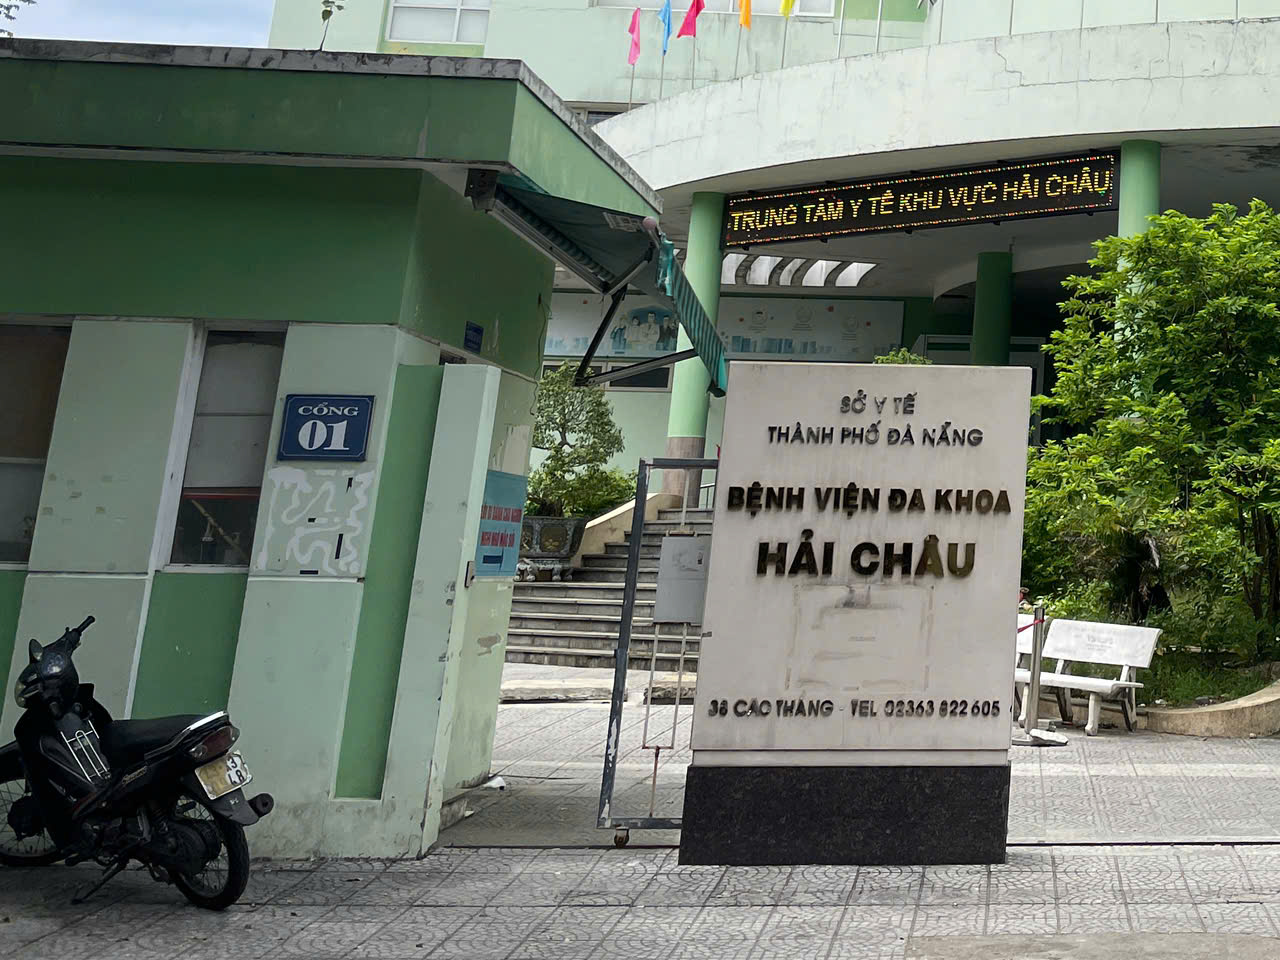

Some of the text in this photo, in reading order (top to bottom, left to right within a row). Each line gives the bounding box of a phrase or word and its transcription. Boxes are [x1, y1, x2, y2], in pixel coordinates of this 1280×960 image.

[731, 204, 797, 232] TRUNG
[850, 199, 863, 218] Y
[899, 190, 943, 212] KHU
[1046, 167, 1110, 197] CHÂU
[840, 389, 918, 414] SỞ Y TẾ
[298, 419, 350, 450] 01
[840, 420, 881, 445] PHỐ
[727, 481, 1012, 520] BỆNH VIỆN ĐA KHOA
[756, 528, 977, 578] HẢI CHÂU
[733, 698, 772, 718] CAO
[851, 699, 878, 718] TEL
[971, 700, 1001, 717] 605
